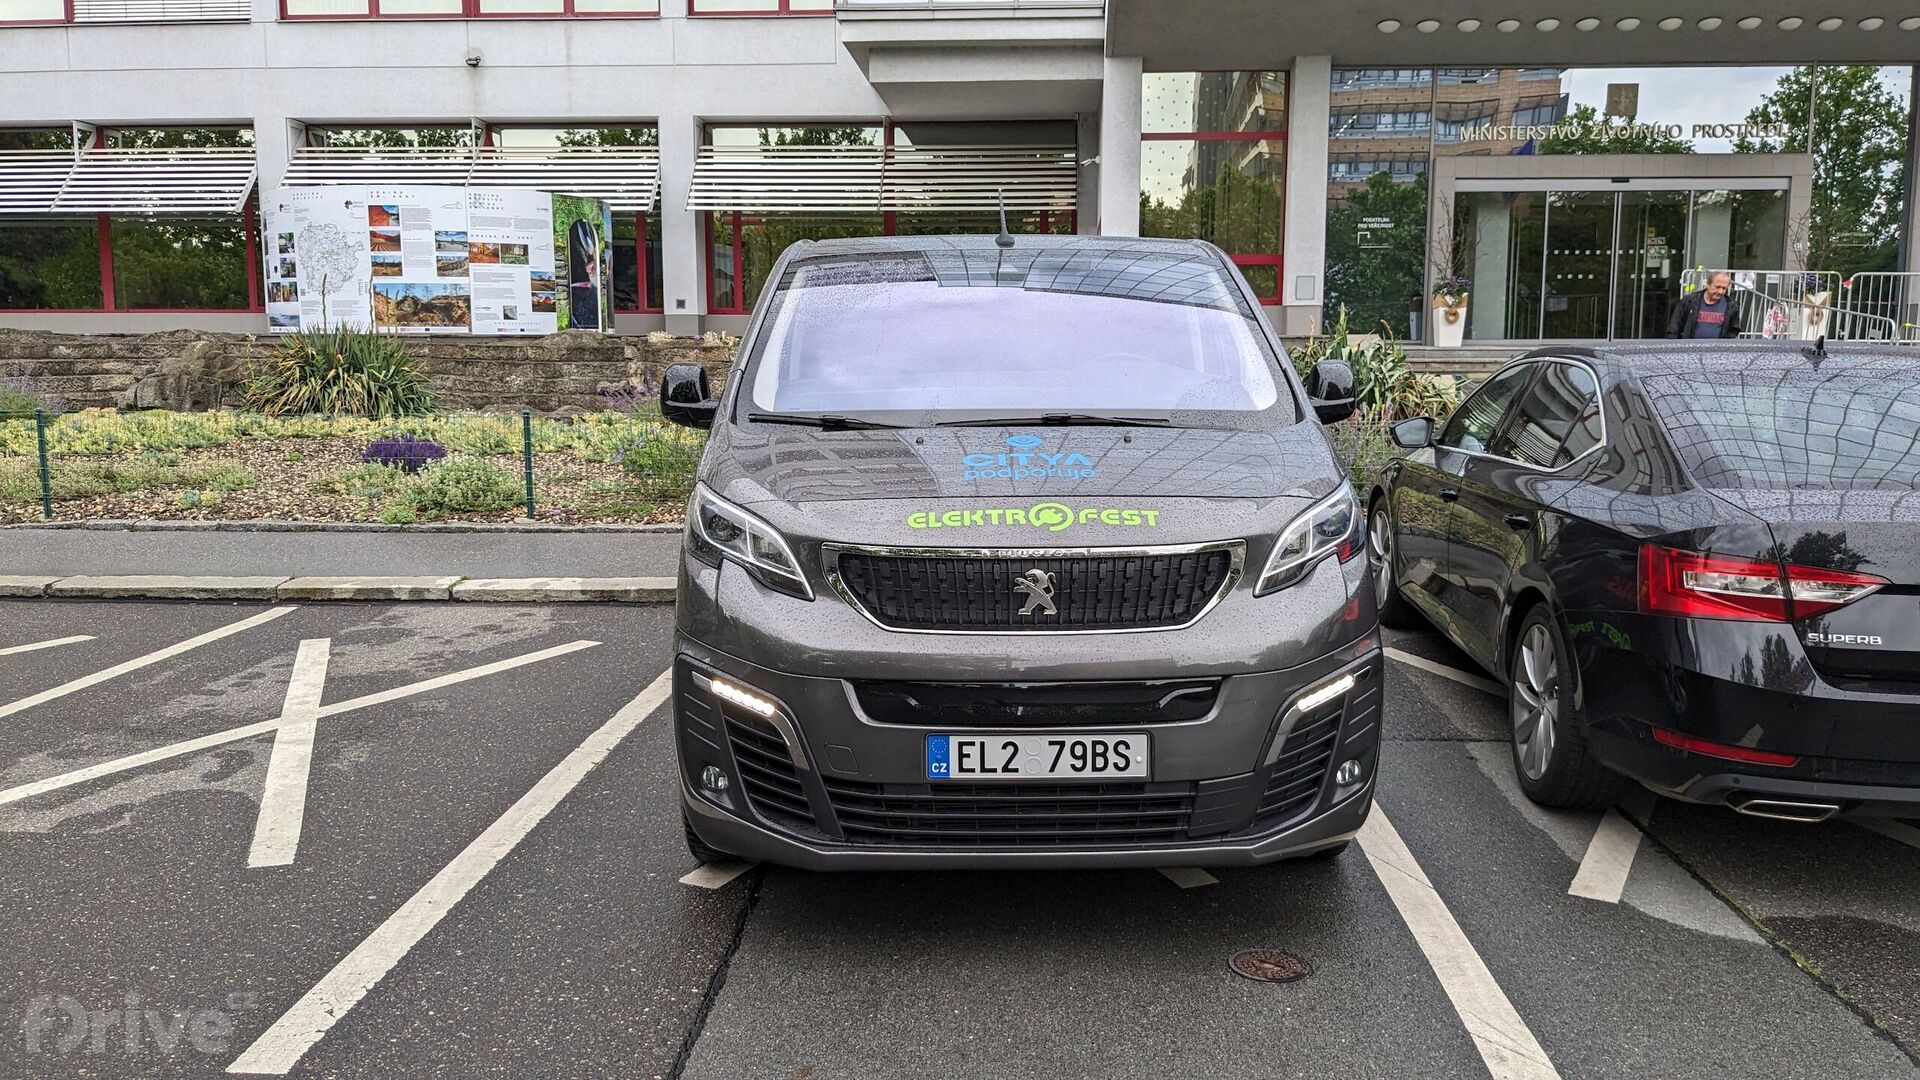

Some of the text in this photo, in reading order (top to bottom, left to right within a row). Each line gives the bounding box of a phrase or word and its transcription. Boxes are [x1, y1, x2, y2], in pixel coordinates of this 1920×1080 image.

[1460, 125, 1581, 141] MINISTERSTVO
[963, 453, 1094, 467] CITYA
[963, 467, 1096, 481] podporuje
[1807, 632, 1882, 645] SUPERB
[957, 740, 1131, 774] EL2 79BS
[931, 763, 948, 773] CZ
